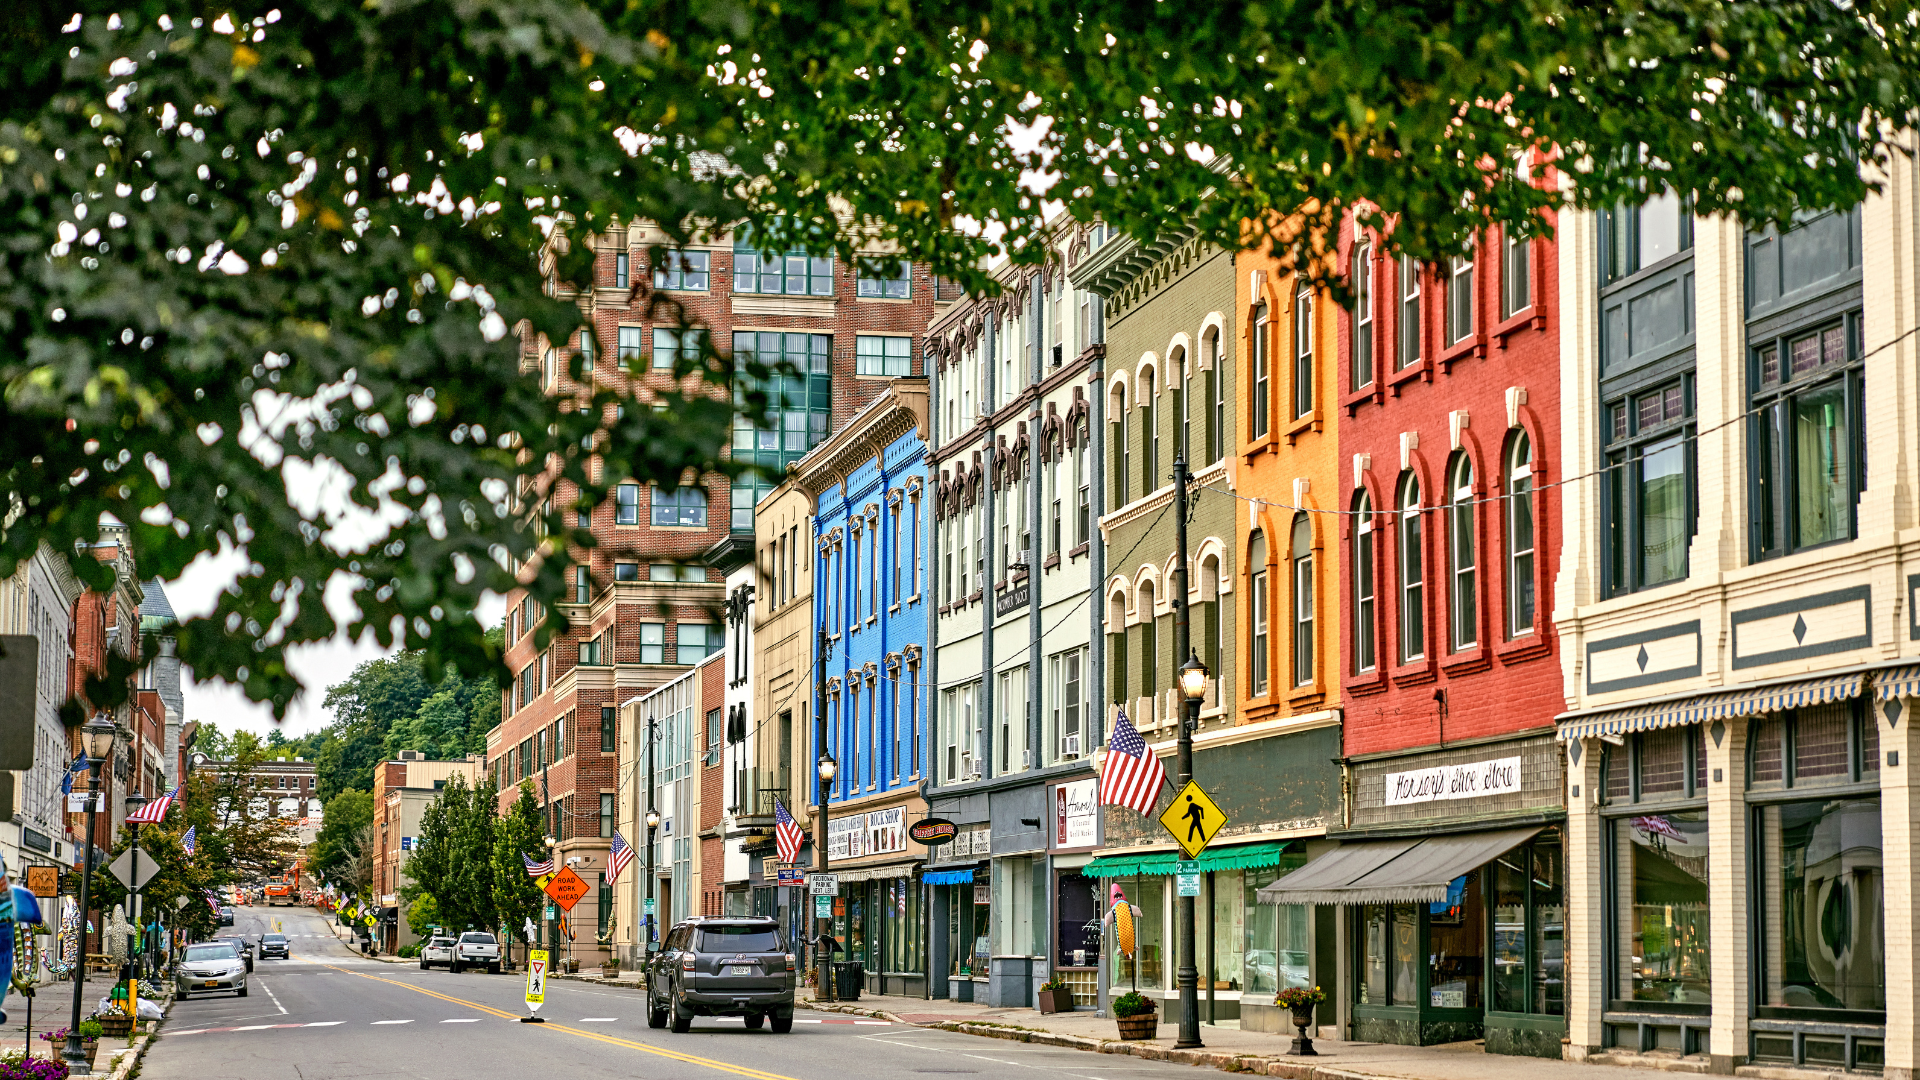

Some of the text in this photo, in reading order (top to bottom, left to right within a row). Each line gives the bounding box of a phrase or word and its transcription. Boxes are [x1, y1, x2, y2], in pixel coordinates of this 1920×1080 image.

[1015, 589, 1028, 605] BLOCK
[1451, 767, 1477, 793] Shoe
[1483, 763, 1513, 790] Store
[870, 809, 900, 826] ROCK SHOP
[913, 825, 955, 838] COFFEE HOUSE
[1177, 863, 1182, 873] 2
